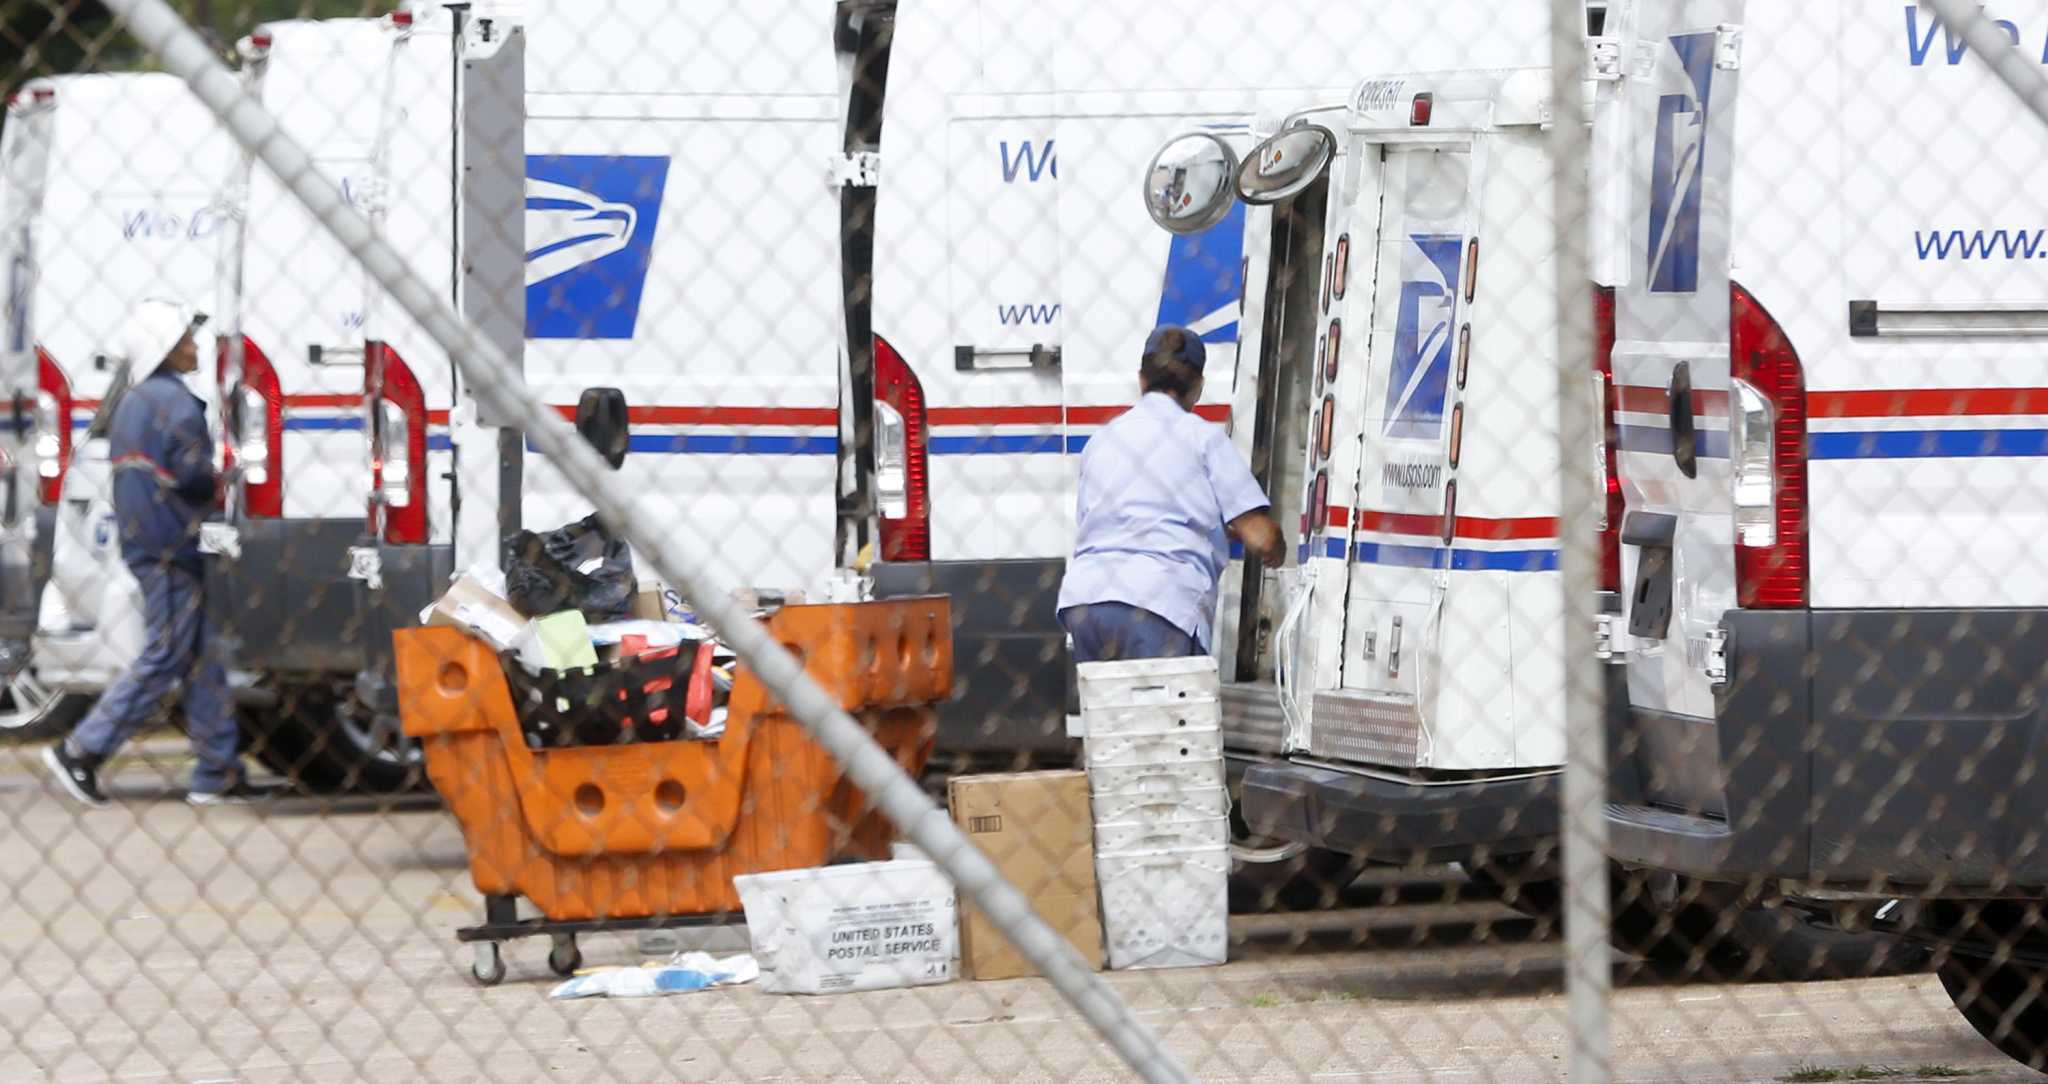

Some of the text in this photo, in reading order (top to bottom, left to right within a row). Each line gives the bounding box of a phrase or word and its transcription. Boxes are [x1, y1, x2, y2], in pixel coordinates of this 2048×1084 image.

[1000, 140, 1057, 183] W
[1383, 463, 1441, 488] www.usps.com
[831, 922, 934, 943] UNITED STATES
[828, 938, 941, 959] POSTAL SERVICE
